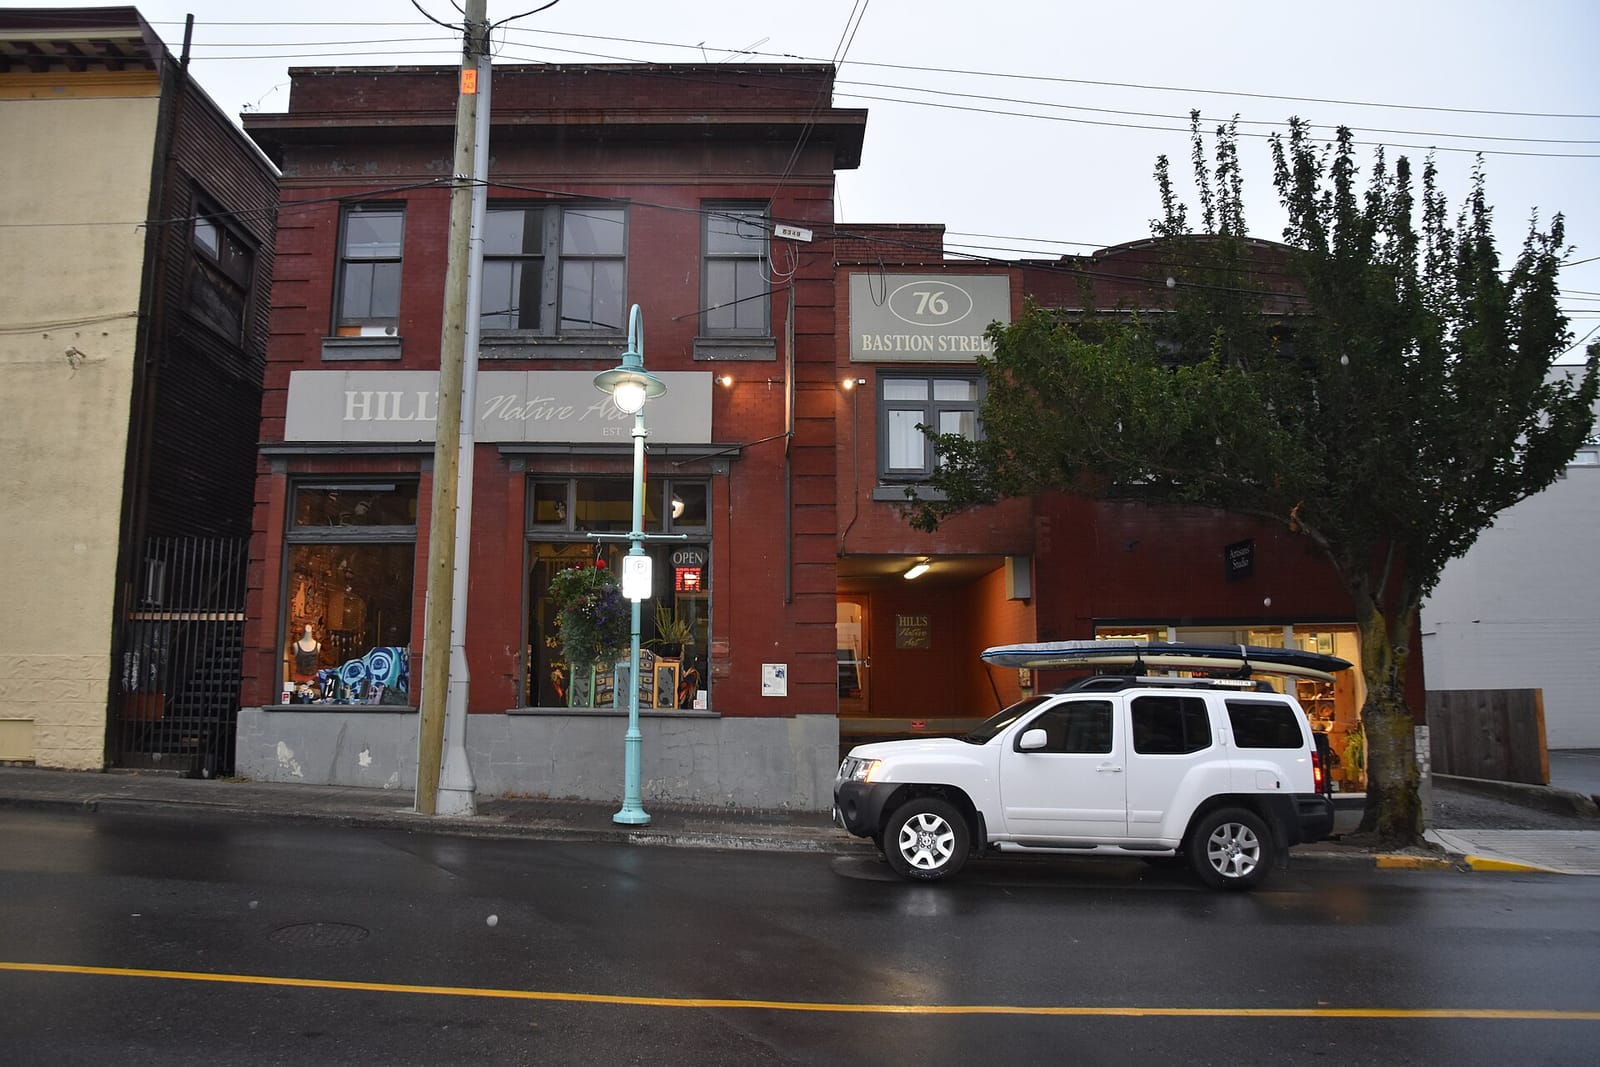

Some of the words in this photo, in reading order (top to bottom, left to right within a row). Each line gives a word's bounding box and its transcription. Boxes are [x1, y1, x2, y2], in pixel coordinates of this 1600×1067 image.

[912, 291, 949, 315] 76
[862, 334, 934, 351] BASTION
[481, 394, 575, 421] Native
[673, 551, 704, 564] OPEN
